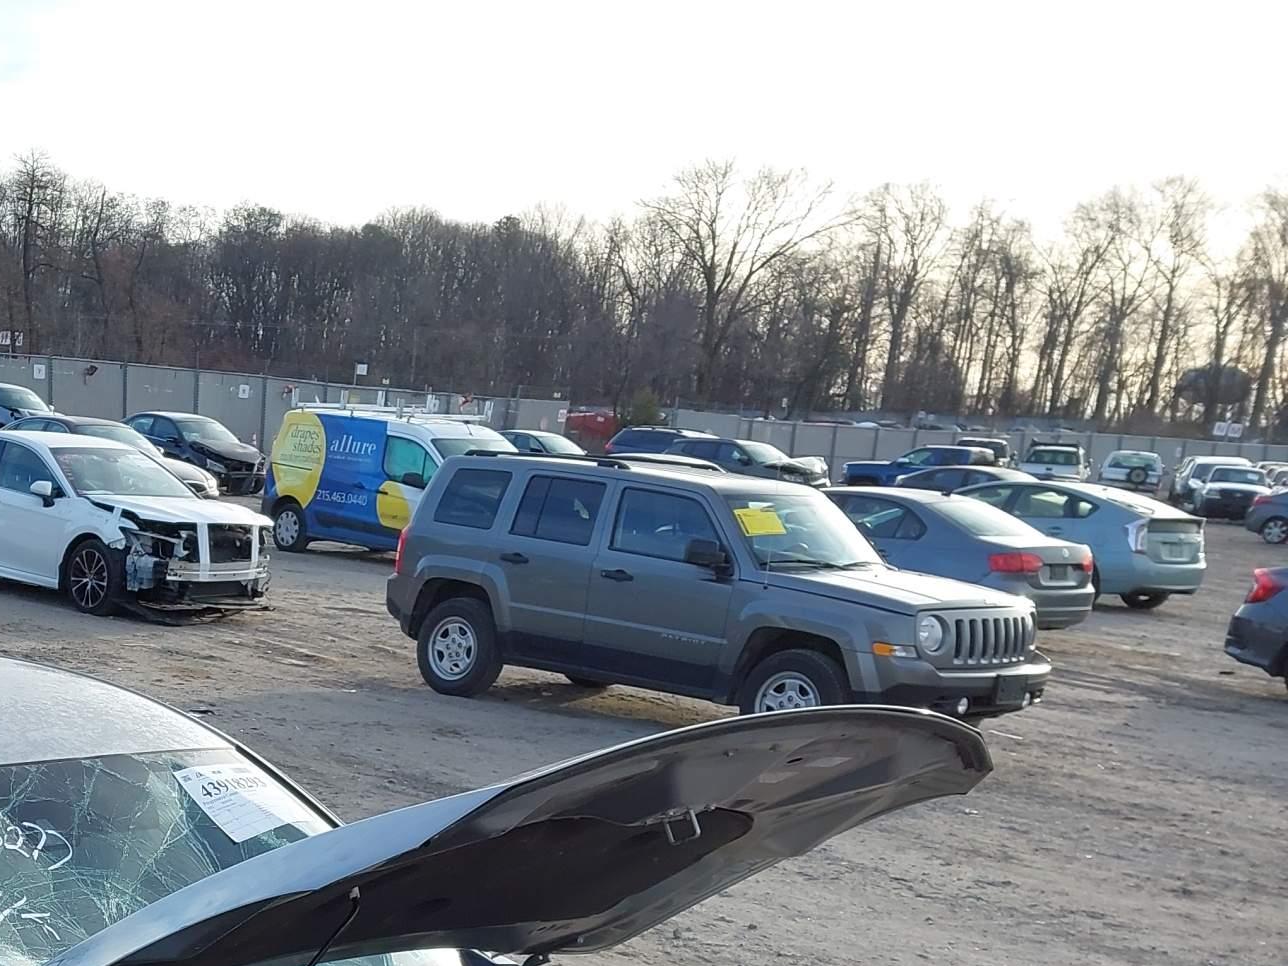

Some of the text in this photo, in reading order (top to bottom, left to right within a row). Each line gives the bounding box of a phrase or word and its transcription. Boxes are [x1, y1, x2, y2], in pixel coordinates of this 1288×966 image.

[291, 425, 321, 442] drapes
[292, 439, 322, 454] shades
[329, 434, 377, 456] allure
[316, 489, 368, 506] 215.463.0440
[200, 776, 268, 799] 43918293
